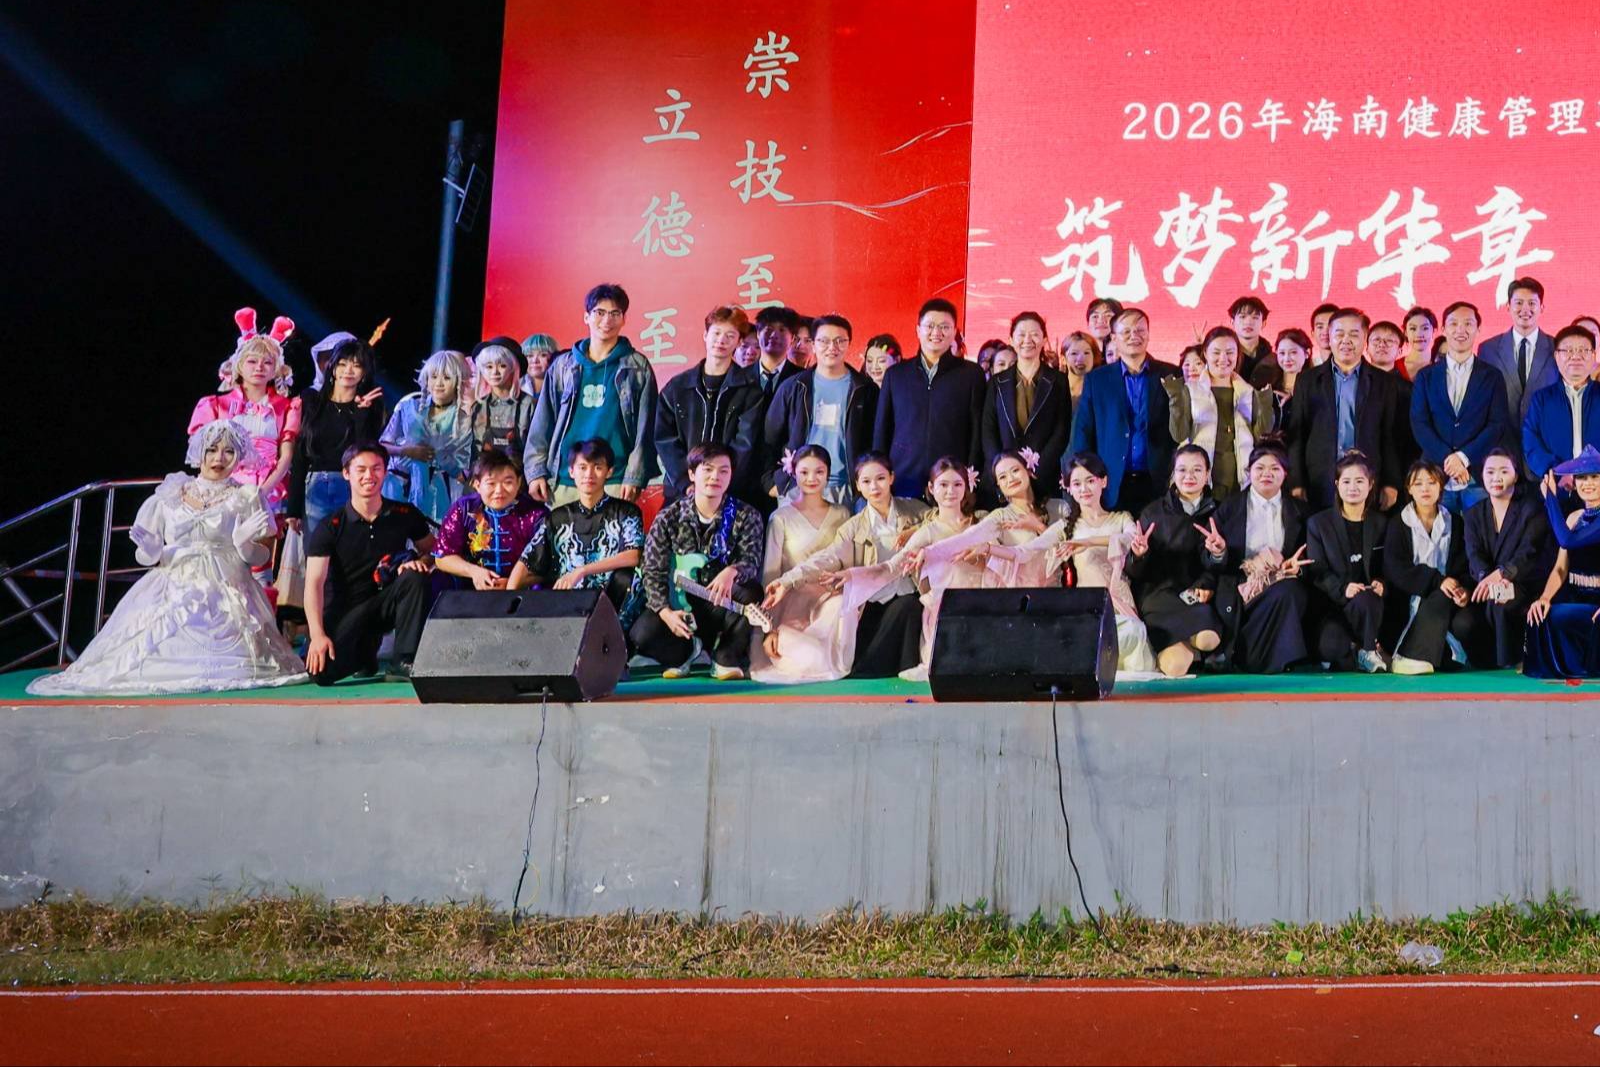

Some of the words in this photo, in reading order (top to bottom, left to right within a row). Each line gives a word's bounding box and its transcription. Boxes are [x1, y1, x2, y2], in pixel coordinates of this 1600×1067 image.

[1040, 182, 1555, 310] 筑梦新华章
